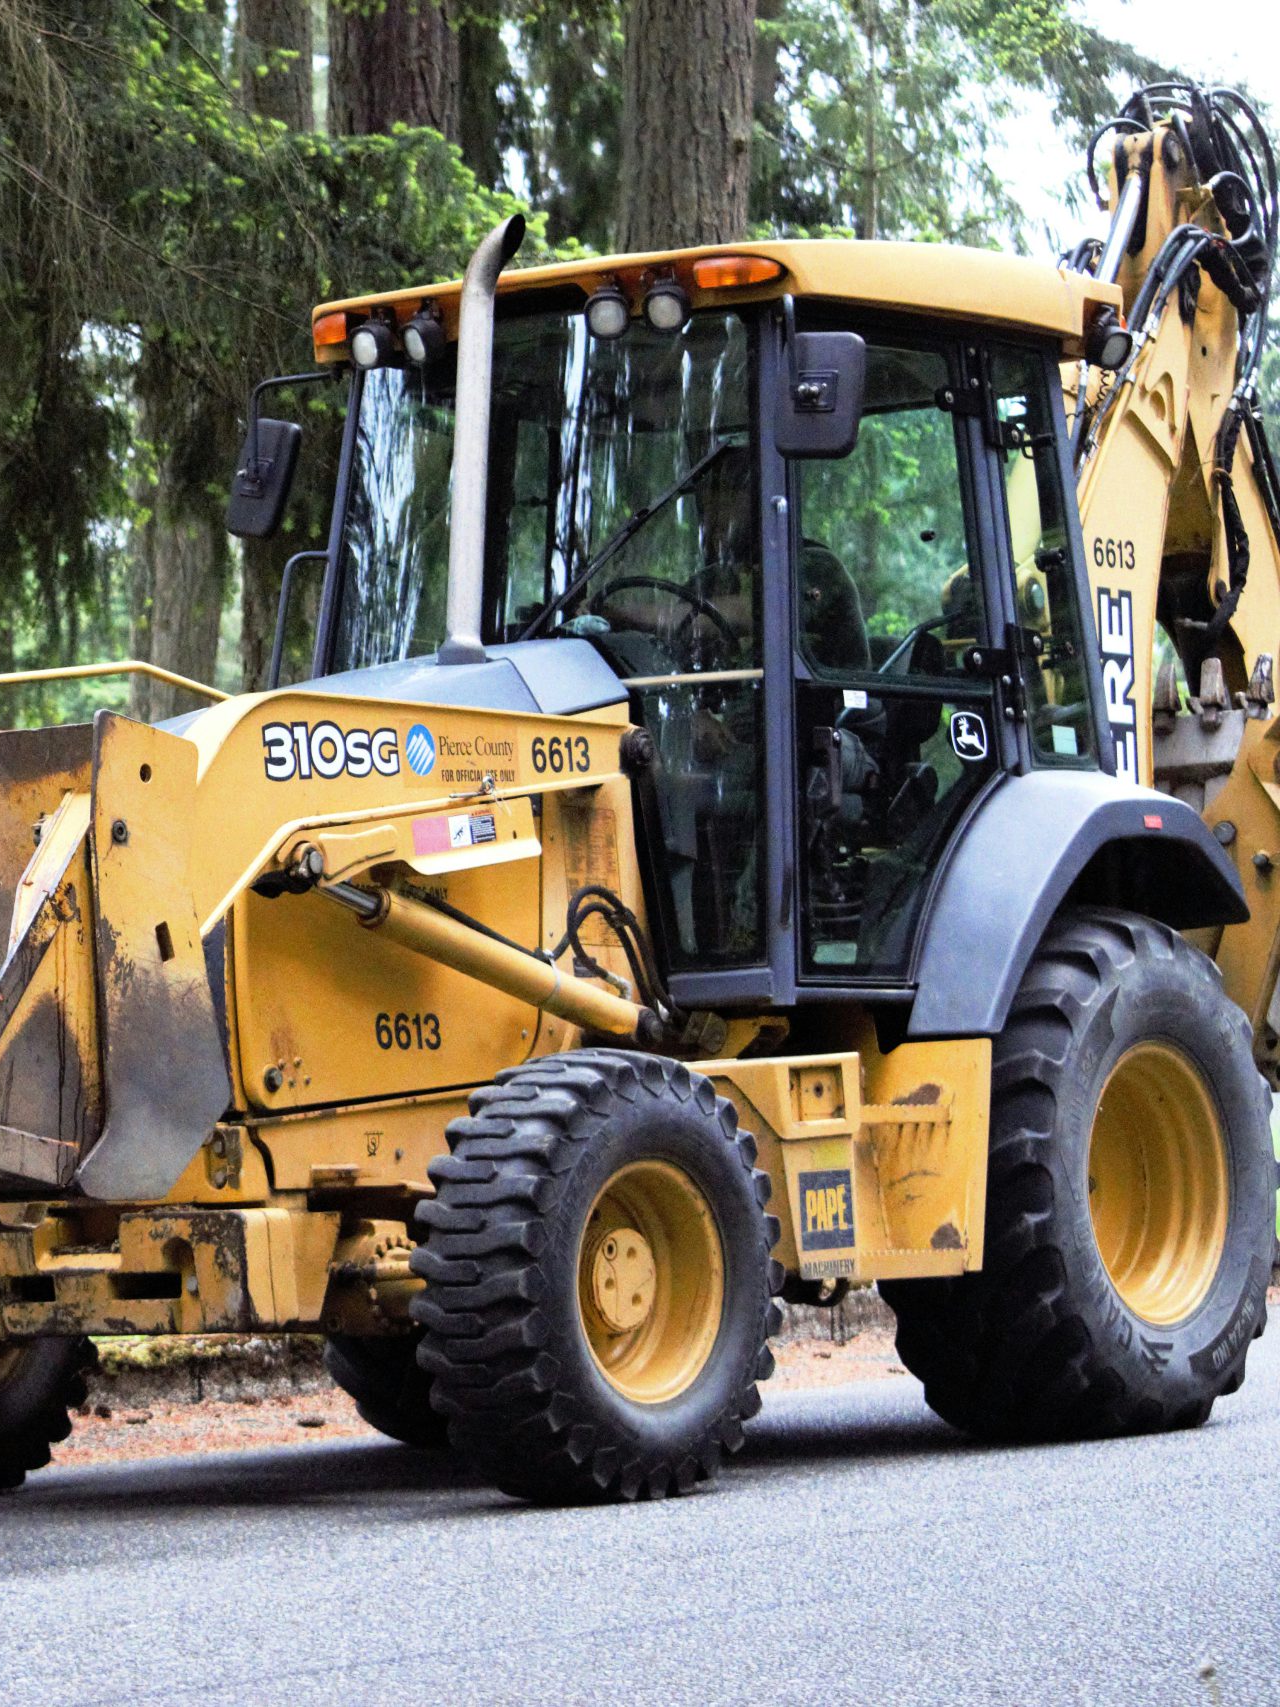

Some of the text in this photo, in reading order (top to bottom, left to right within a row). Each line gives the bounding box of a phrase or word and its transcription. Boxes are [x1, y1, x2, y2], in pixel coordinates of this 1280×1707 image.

[1093, 537, 1135, 570] 6613
[262, 720, 400, 782] 310SG
[438, 735, 513, 761] Pierce County
[532, 736, 590, 773] 6613
[441, 769, 454, 782] FOR
[456, 769, 483, 782] OFFICIAL
[500, 769, 515, 782] ONLY
[375, 1012, 441, 1050] 6613
